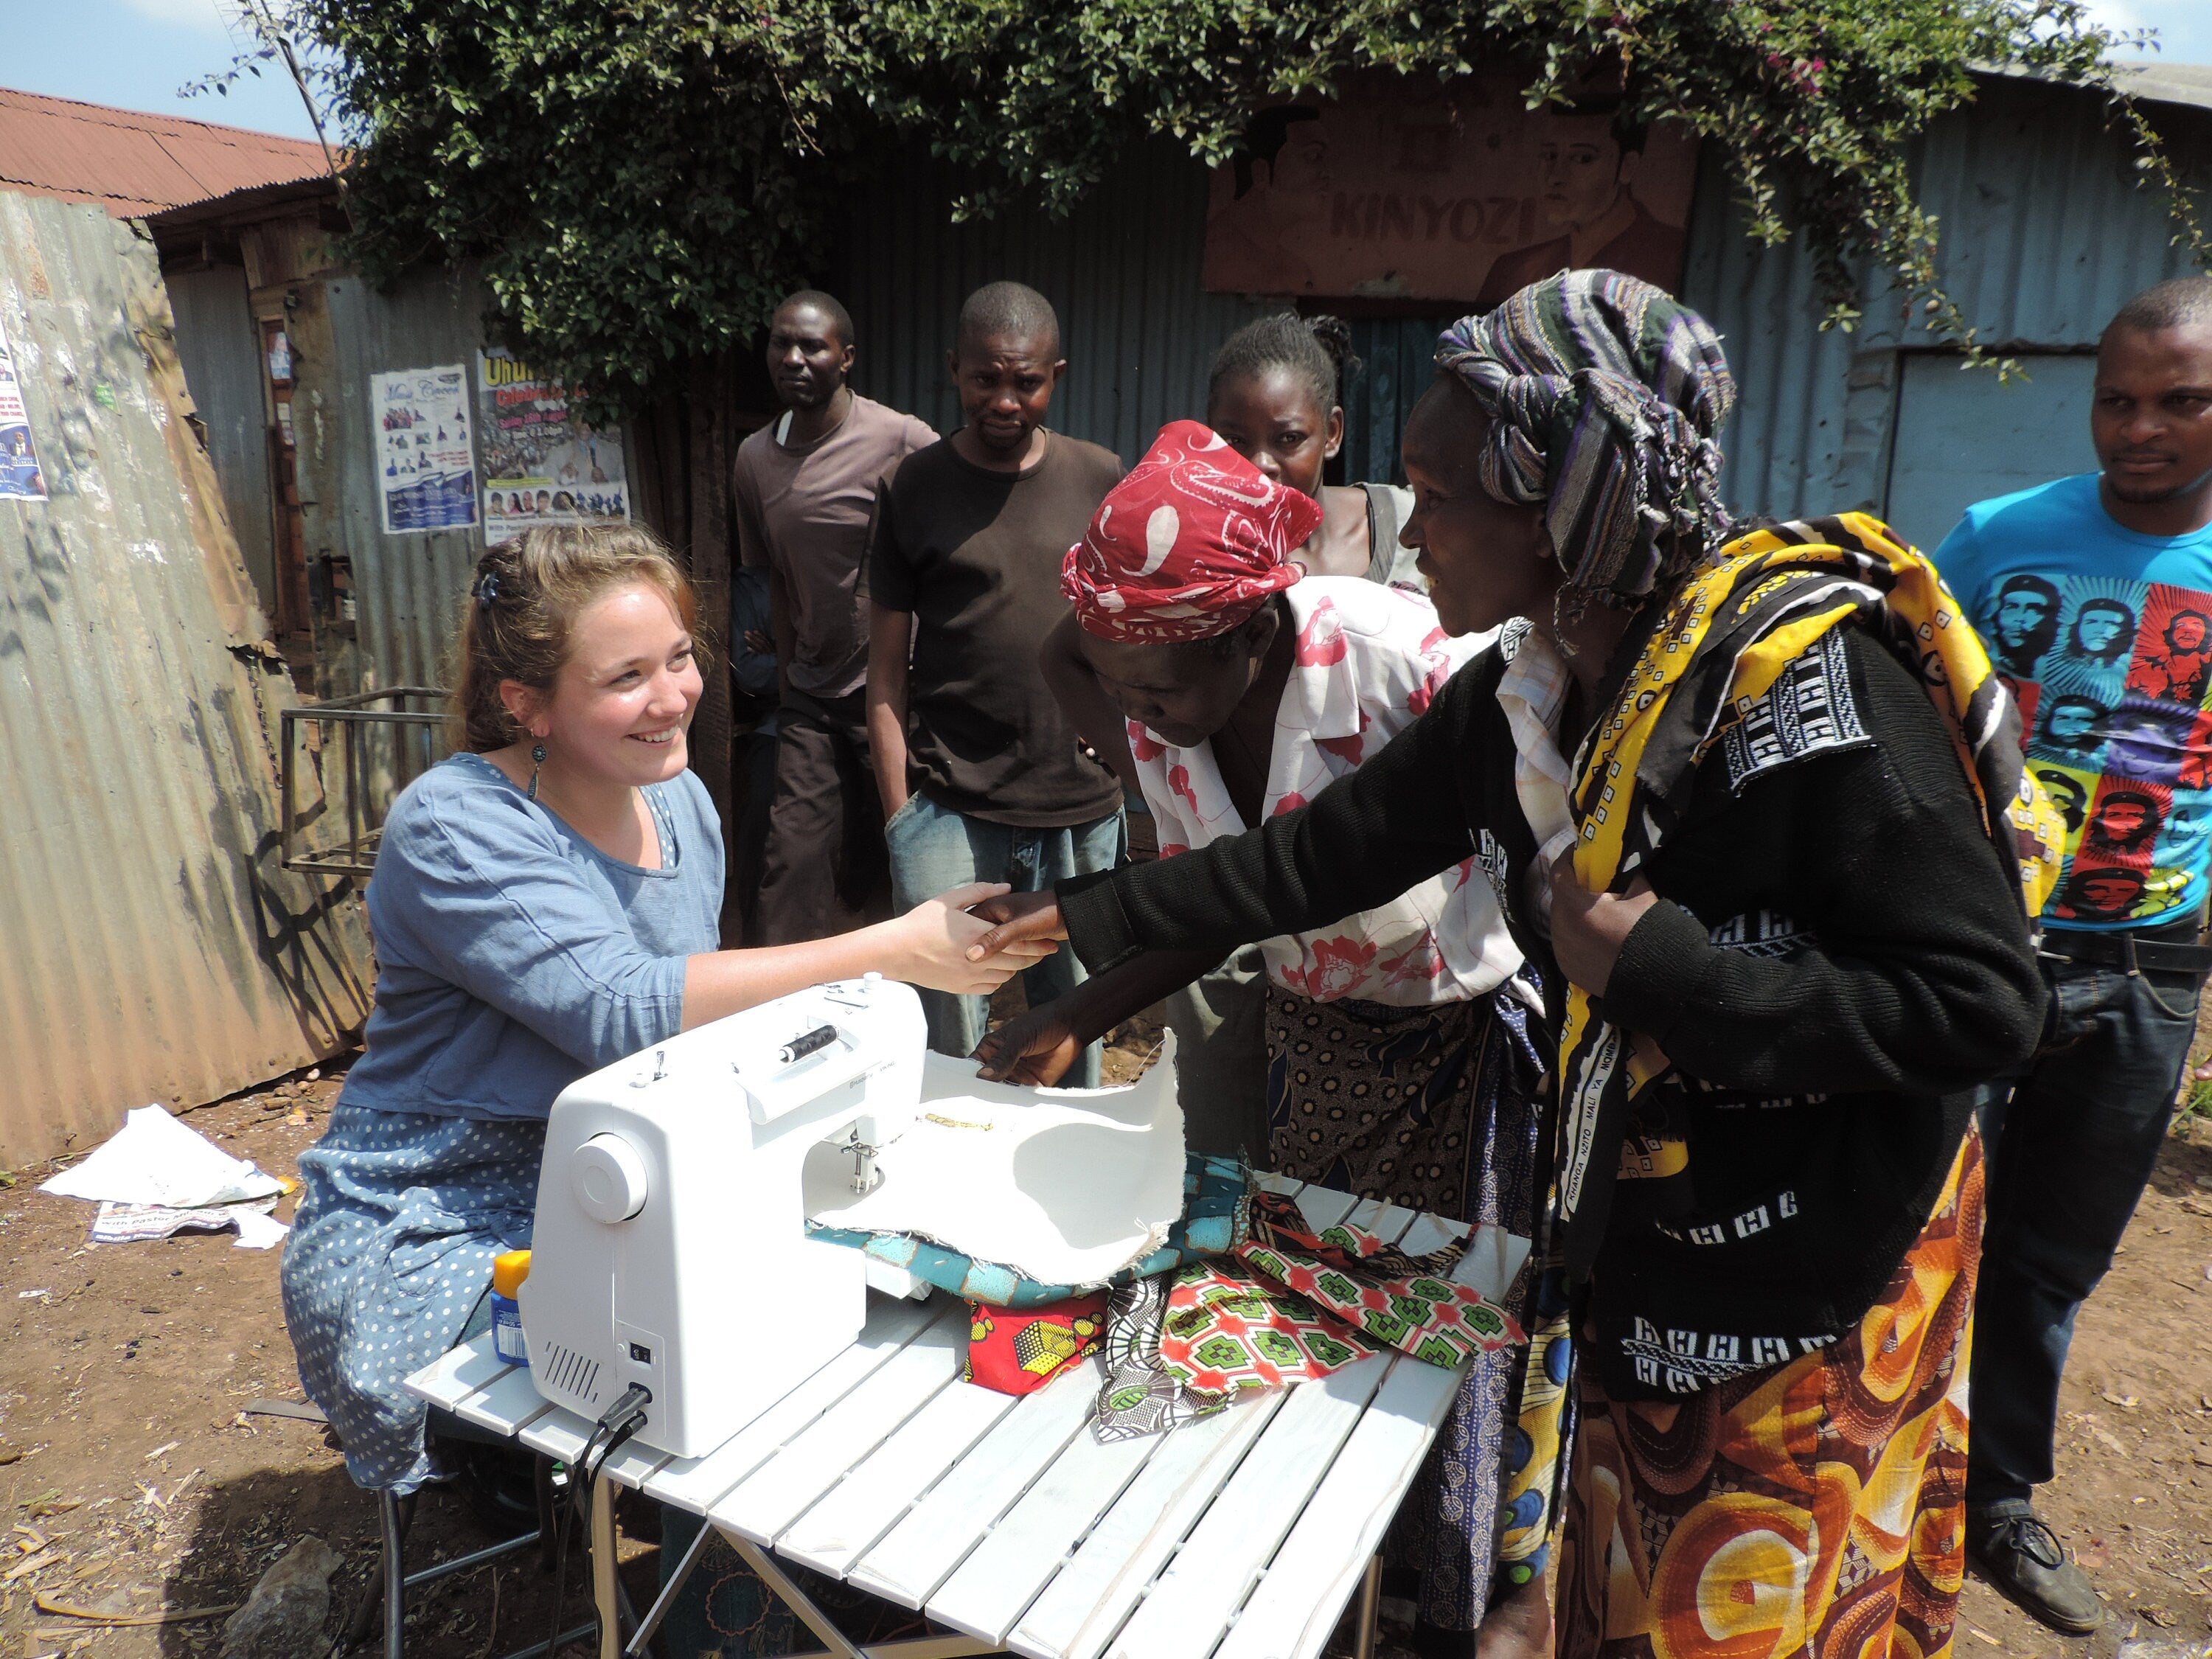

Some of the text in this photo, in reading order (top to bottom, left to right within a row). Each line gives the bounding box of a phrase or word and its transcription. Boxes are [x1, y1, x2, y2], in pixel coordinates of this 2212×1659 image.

[1329, 191, 1537, 244] KINYOZI
[1591, 1079, 1604, 1090] YA
[1586, 1096, 1597, 1120] MALI
[1581, 1129, 1592, 1156] NZITO
